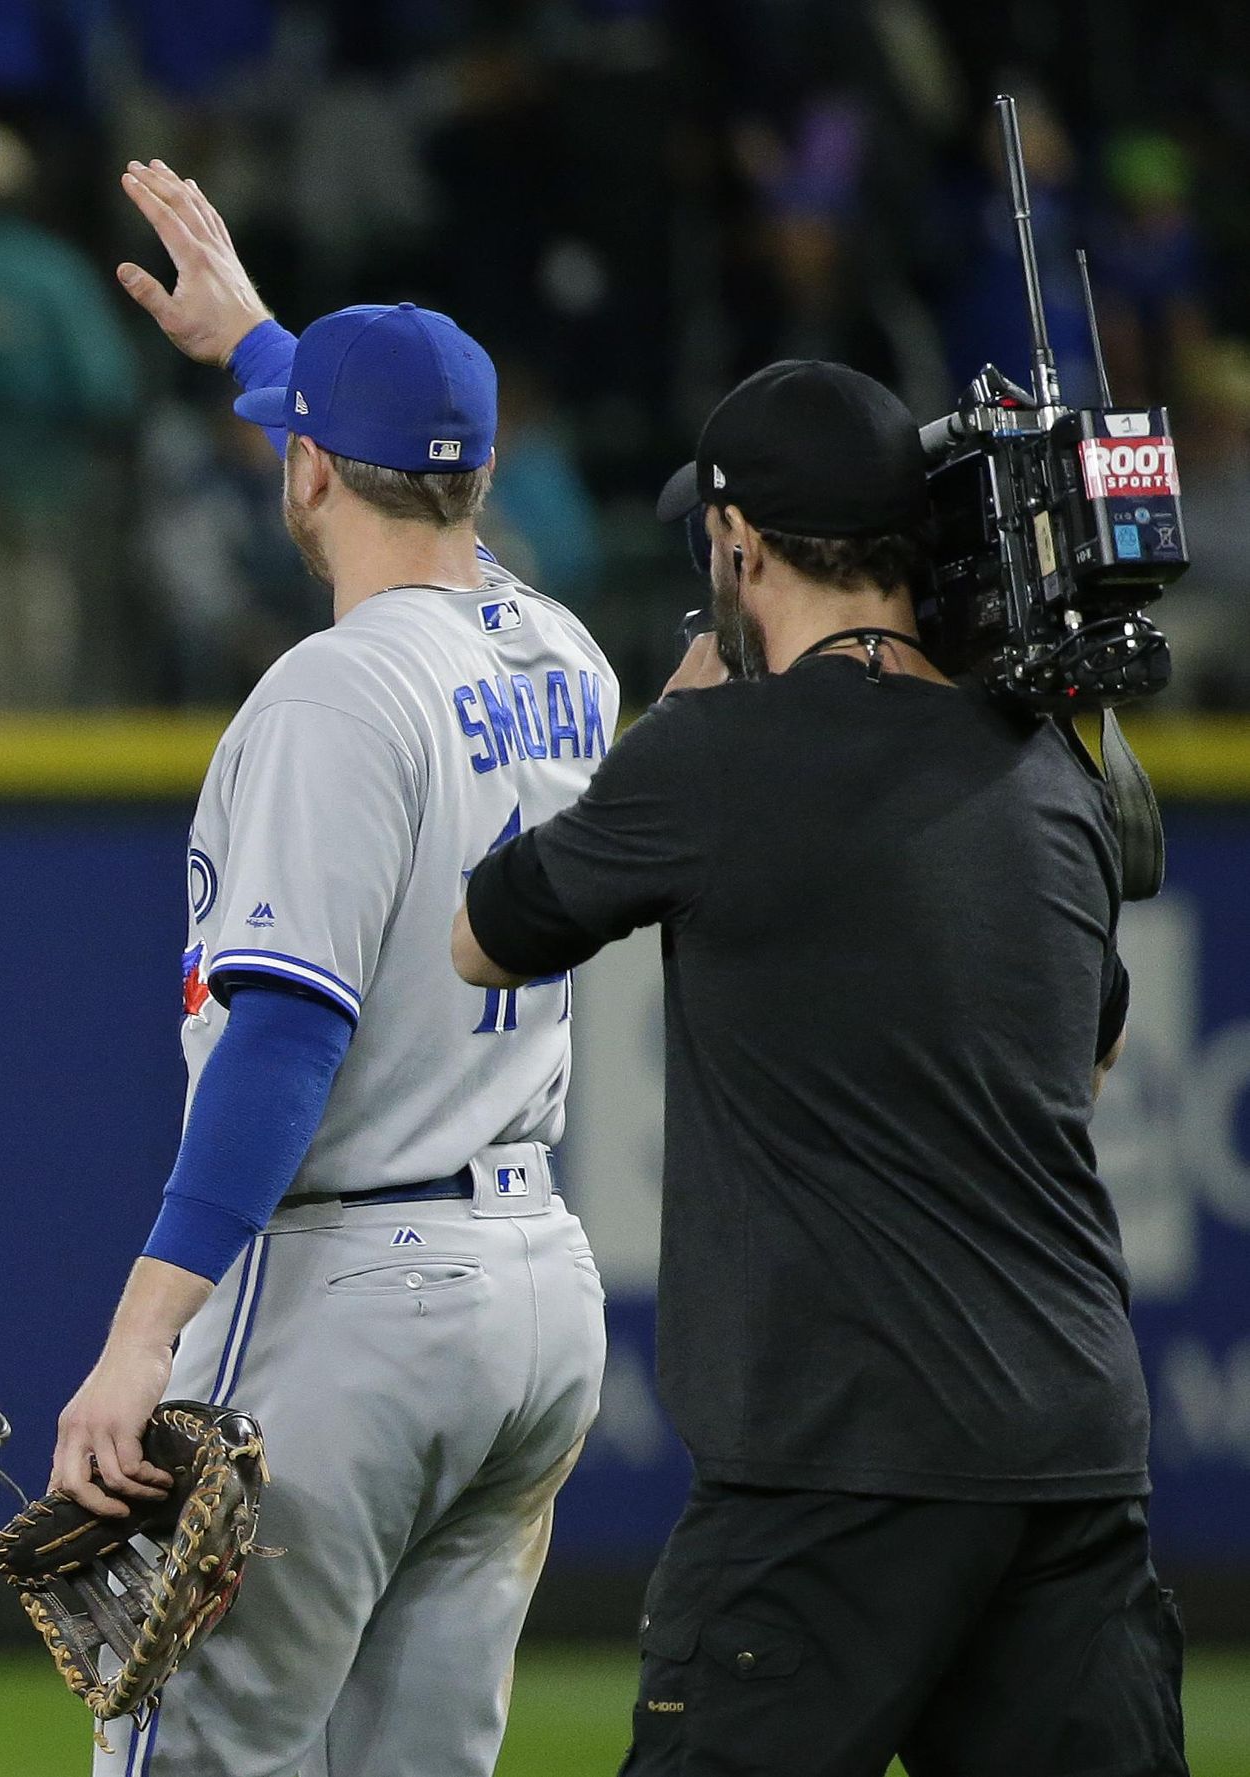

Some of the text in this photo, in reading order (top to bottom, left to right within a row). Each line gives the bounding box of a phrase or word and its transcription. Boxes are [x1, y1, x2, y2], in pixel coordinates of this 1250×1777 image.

[1121, 416, 1138, 433] 1
[1083, 445, 1176, 476] ROOT
[1107, 475, 1174, 488] SPORTS
[453, 669, 606, 774] SMOAK
